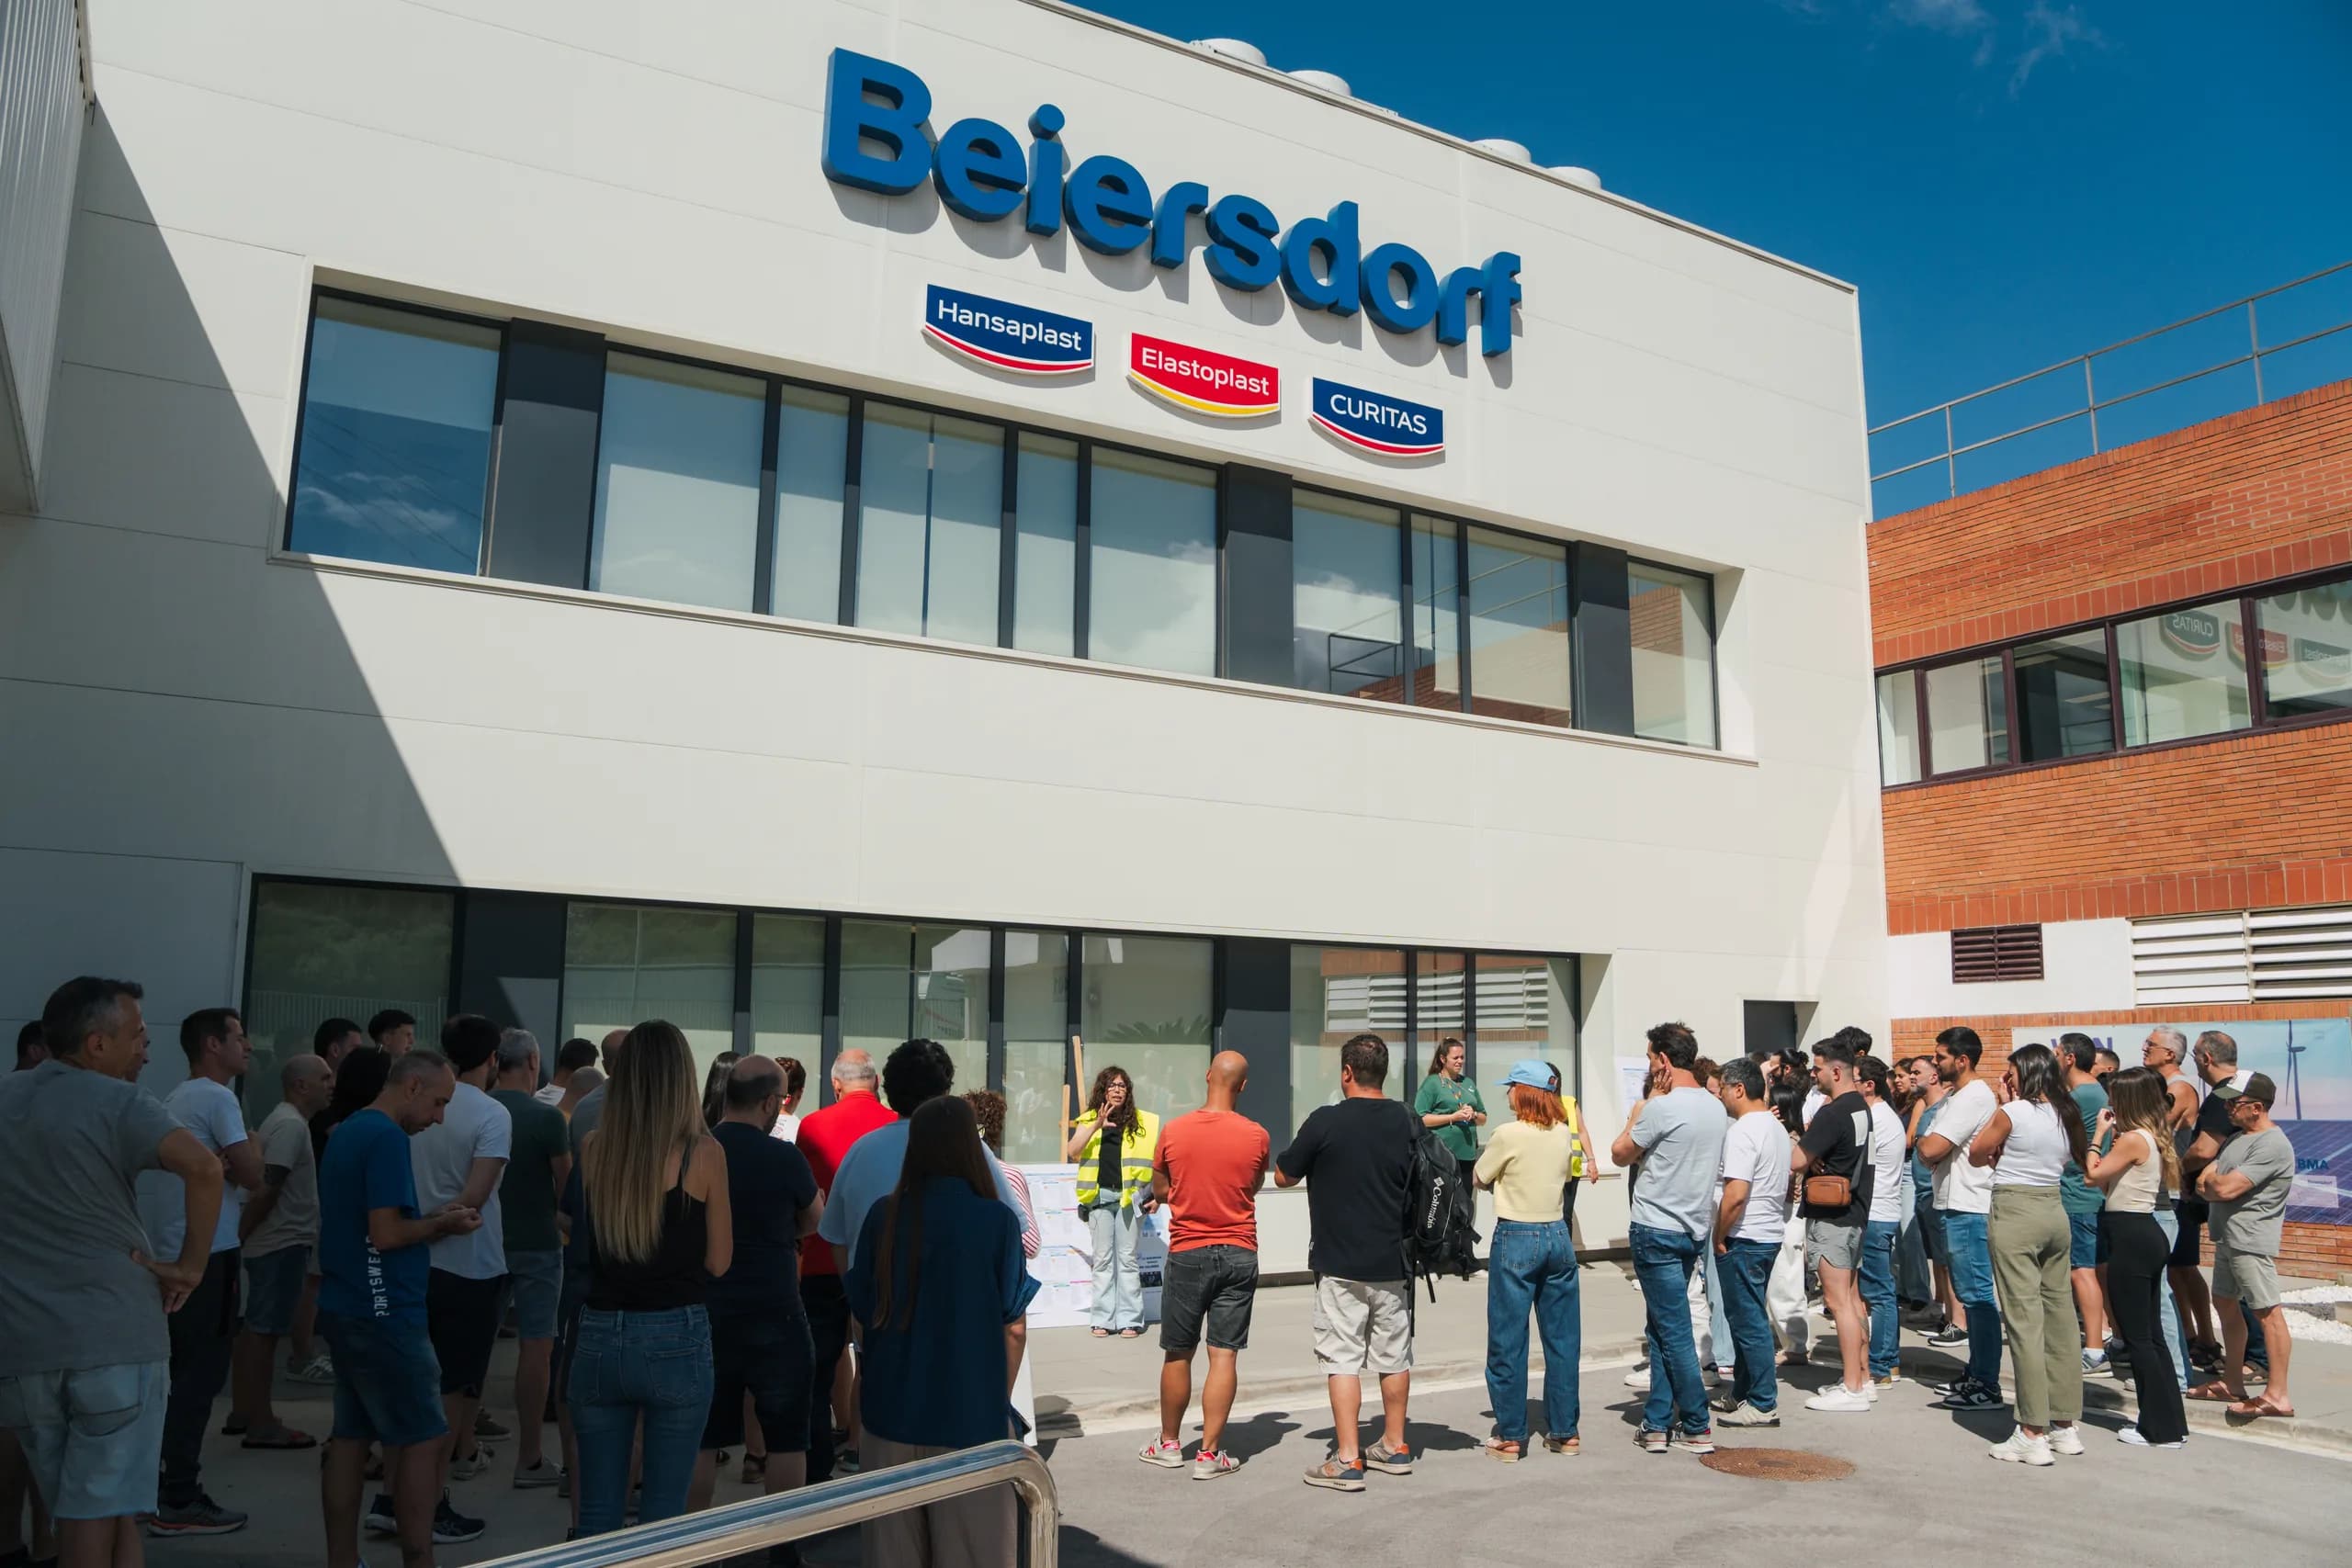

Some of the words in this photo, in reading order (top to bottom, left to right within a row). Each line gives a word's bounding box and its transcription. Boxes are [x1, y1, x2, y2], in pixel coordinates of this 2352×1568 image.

[822, 48, 1521, 357] Beiersdorf
[938, 299, 1082, 352] Hansaplast
[1142, 347, 1270, 396] Elastoplast
[1330, 394, 1427, 434] CURITAS
[2298, 1158, 2329, 1169] BMA
[1427, 1187, 1442, 1228] Columbia
